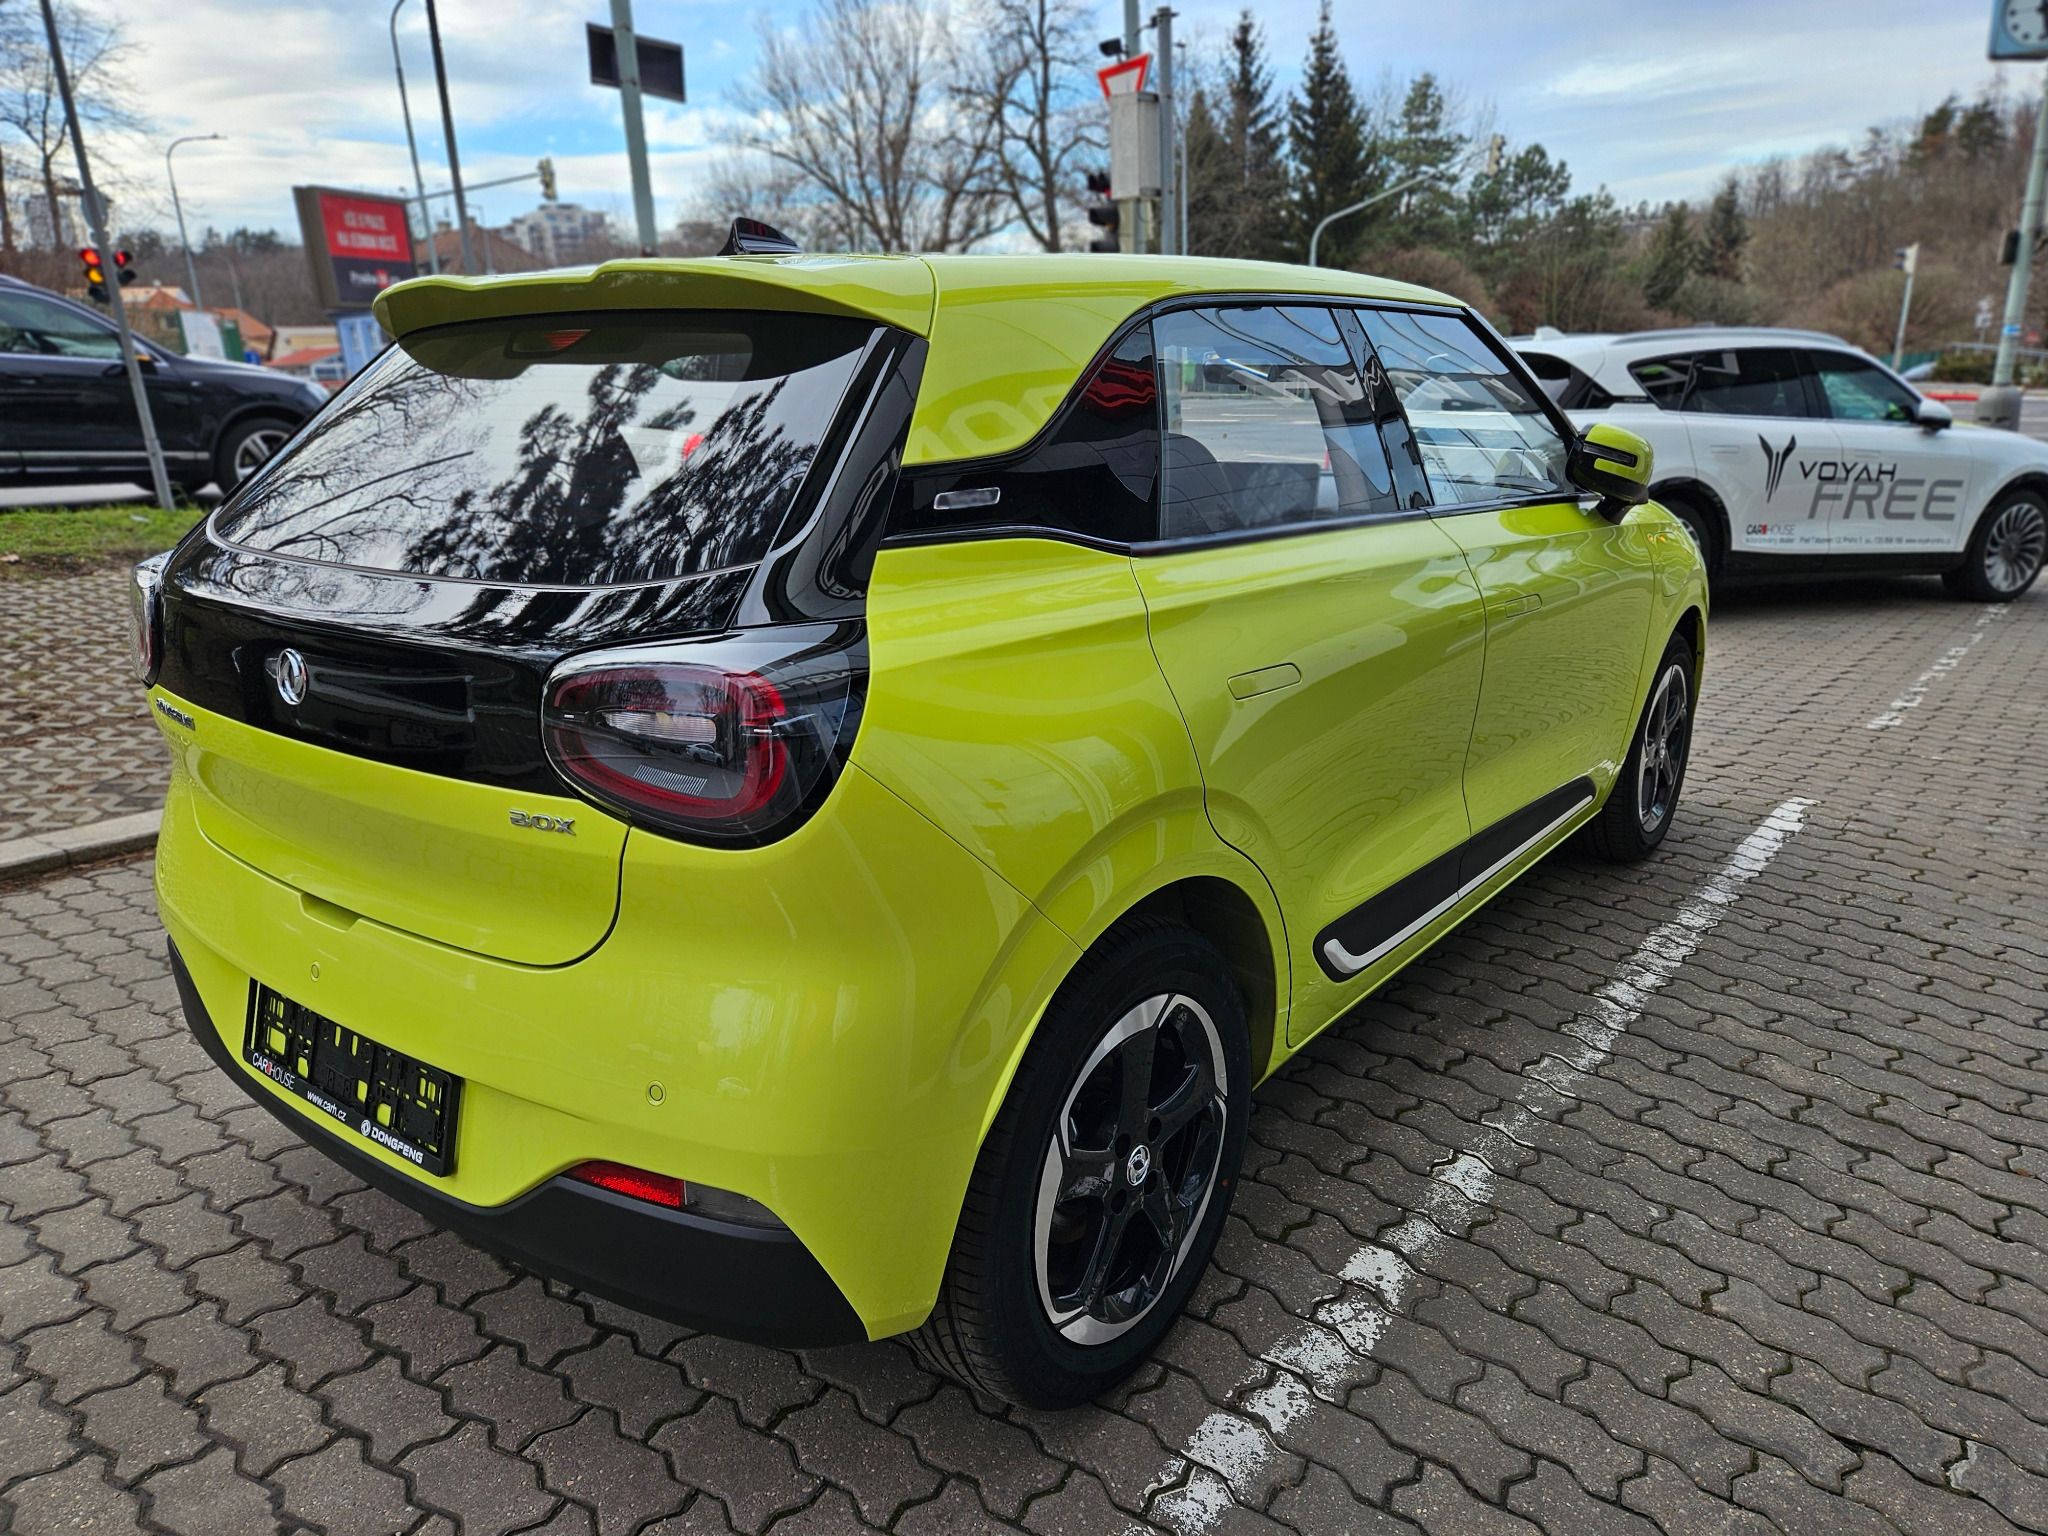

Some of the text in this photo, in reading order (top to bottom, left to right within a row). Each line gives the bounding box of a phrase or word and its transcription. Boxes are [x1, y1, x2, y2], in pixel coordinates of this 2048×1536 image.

[1799, 460, 1898, 482] VOYAH
[1807, 479, 1964, 521] FREE
[307, 1090, 348, 1122] www.carh.cz
[371, 1126, 424, 1164] DONGFENG
